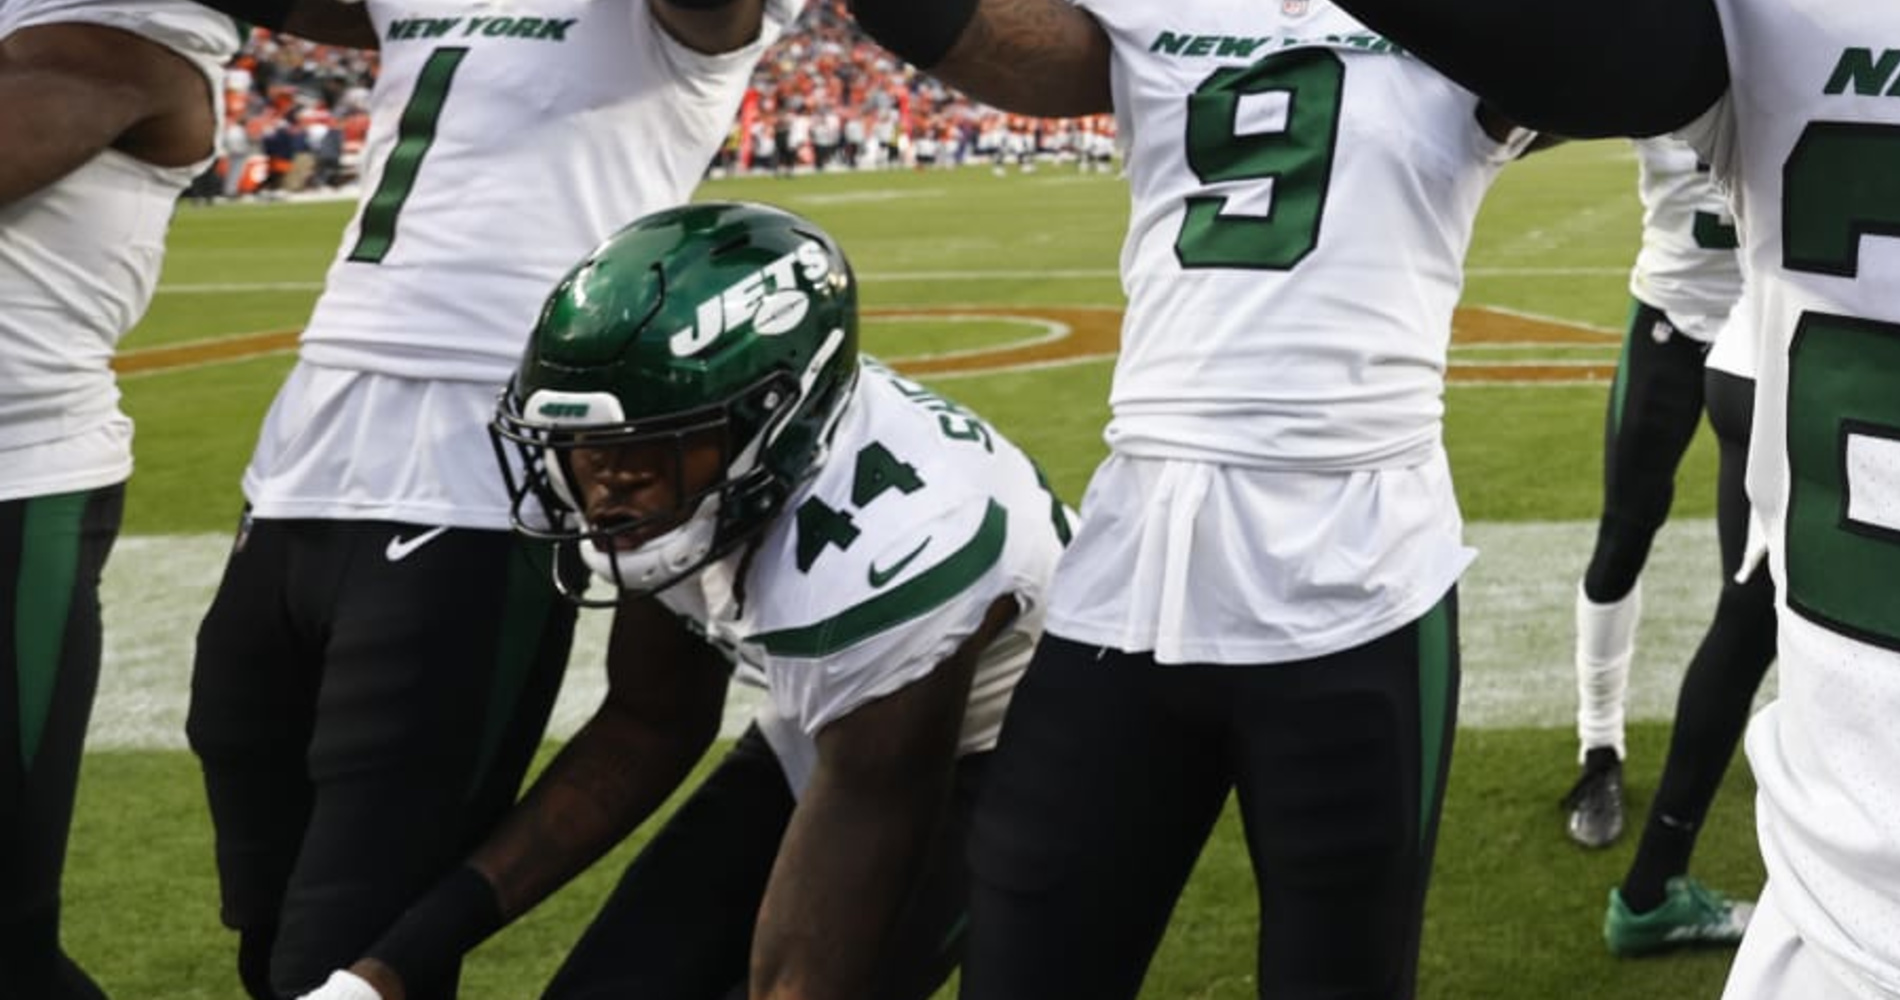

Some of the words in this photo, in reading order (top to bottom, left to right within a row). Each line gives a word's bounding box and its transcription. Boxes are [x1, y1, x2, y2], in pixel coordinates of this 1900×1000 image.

[386, 18, 460, 41] NEW
[462, 17, 579, 42] YORK
[1149, 31, 1270, 57] NEW
[346, 47, 470, 265] 1
[1174, 46, 1345, 271] 9
[670, 241, 829, 358] JETS
[796, 439, 927, 576] 44
